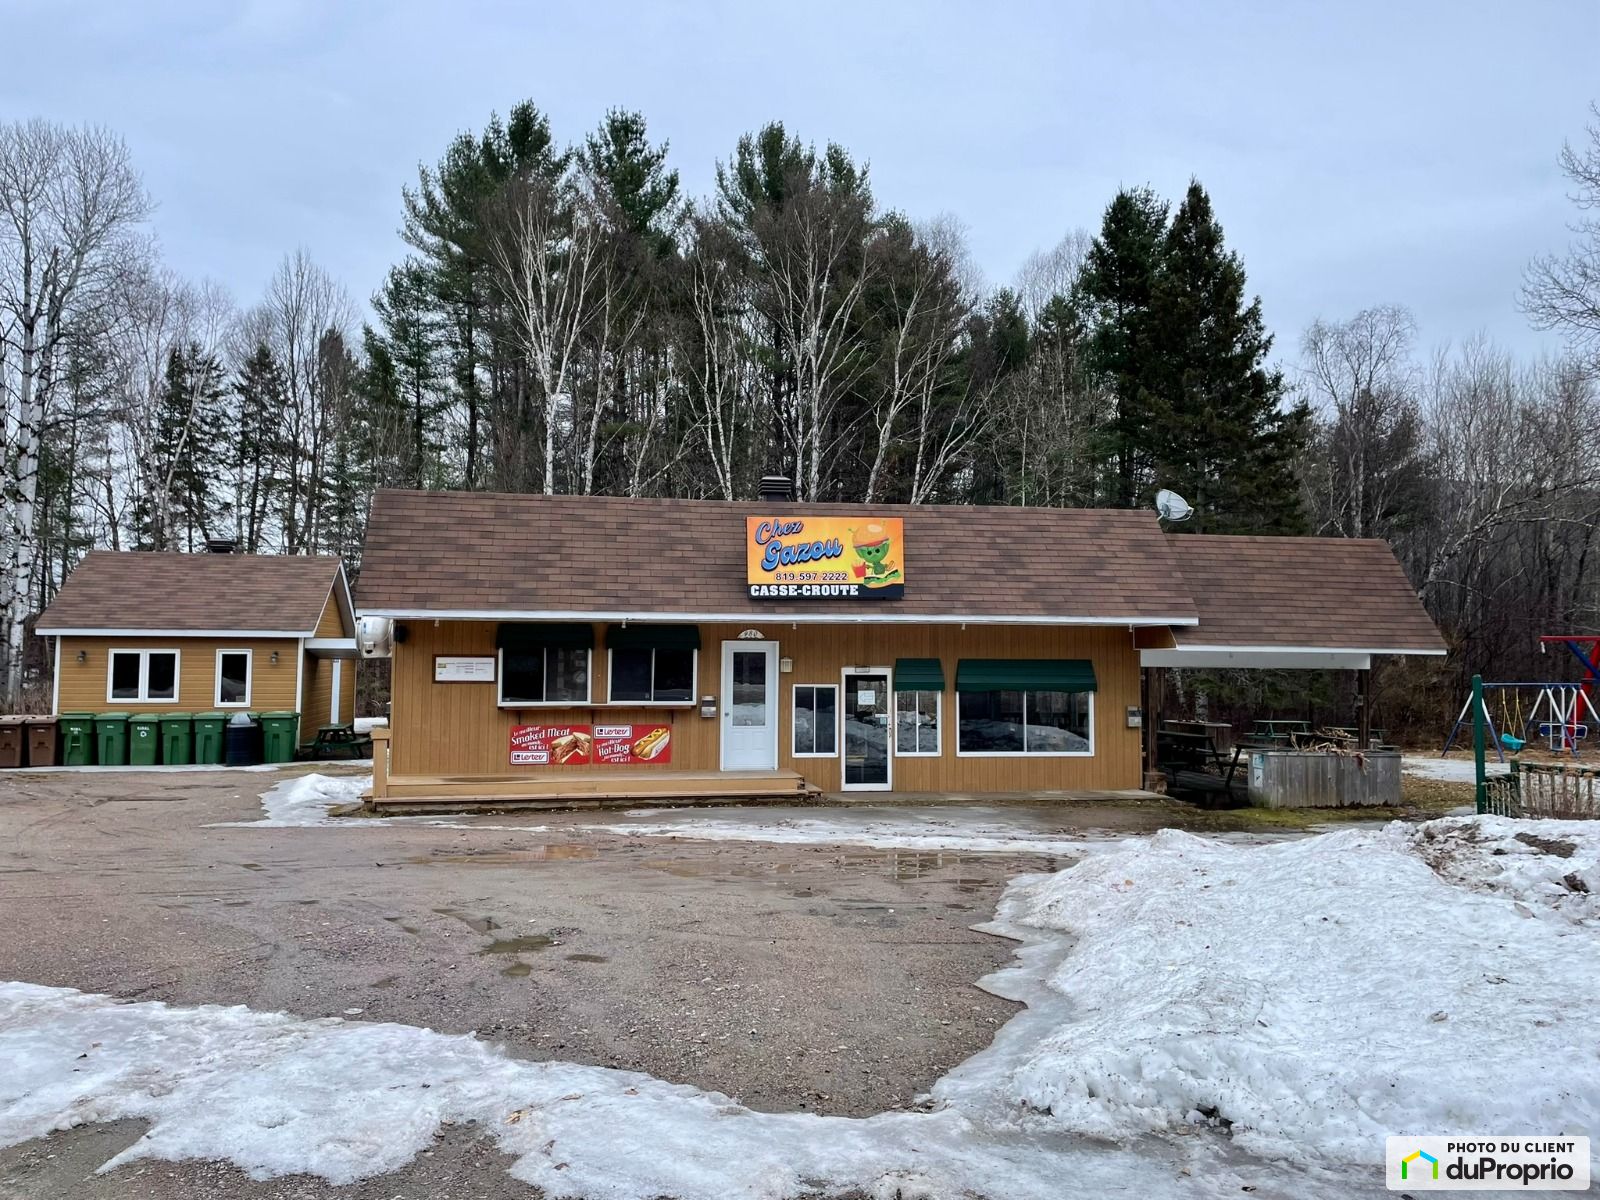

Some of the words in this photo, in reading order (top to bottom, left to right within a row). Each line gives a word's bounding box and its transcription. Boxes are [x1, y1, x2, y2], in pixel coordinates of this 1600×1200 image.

[755, 519, 804, 545] Chez
[761, 538, 844, 572] Gazou
[750, 584, 859, 596] CASSE-CROUTE
[511, 729, 545, 746] Smoked
[547, 727, 570, 738] Meat
